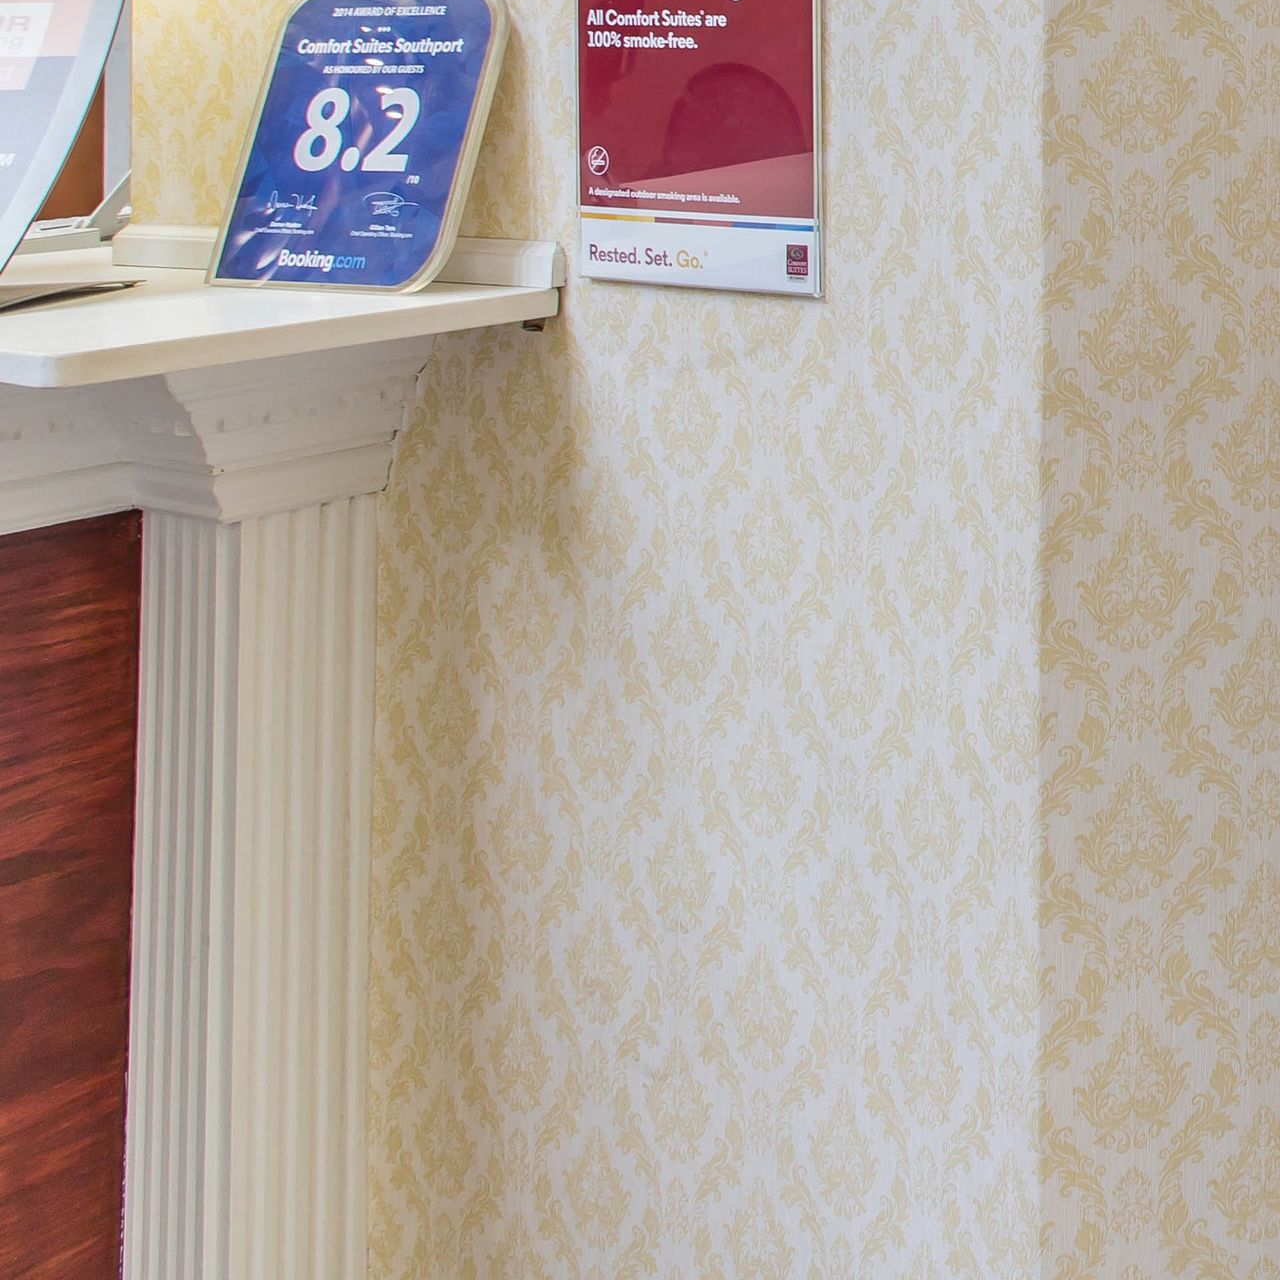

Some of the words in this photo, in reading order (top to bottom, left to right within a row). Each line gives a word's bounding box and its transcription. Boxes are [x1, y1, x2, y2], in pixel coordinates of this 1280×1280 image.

[332, 7, 353, 17] 2014
[354, 7, 384, 17] AWARD
[384, 7, 396, 16] OF
[396, 6, 447, 16] EXCELLENCE
[586, 9, 603, 26] All
[605, 9, 660, 26] Comfort
[705, 14, 727, 27] are
[297, 38, 352, 54] Comfort
[352, 39, 393, 54] Suites
[393, 39, 464, 56] Southport
[587, 31, 621, 48] 100%
[623, 32, 698, 49] smoke-free.
[323, 66, 334, 74] AS
[334, 65, 372, 74] HONOURED
[382, 65, 396, 74] OUR
[397, 65, 424, 74] GUESTS
[294, 87, 421, 172] 8.2
[406, 175, 420, 185] /10
[588, 187, 594, 195] A
[595, 188, 630, 198] designated
[631, 190, 657, 199] outdoor
[657, 192, 686, 202] smoking
[687, 194, 701, 202] area
[702, 193, 708, 202] is
[709, 193, 741, 204] available.
[278, 249, 366, 272] Booking.com
[589, 244, 641, 265] Rested.
[644, 247, 672, 267] Set.
